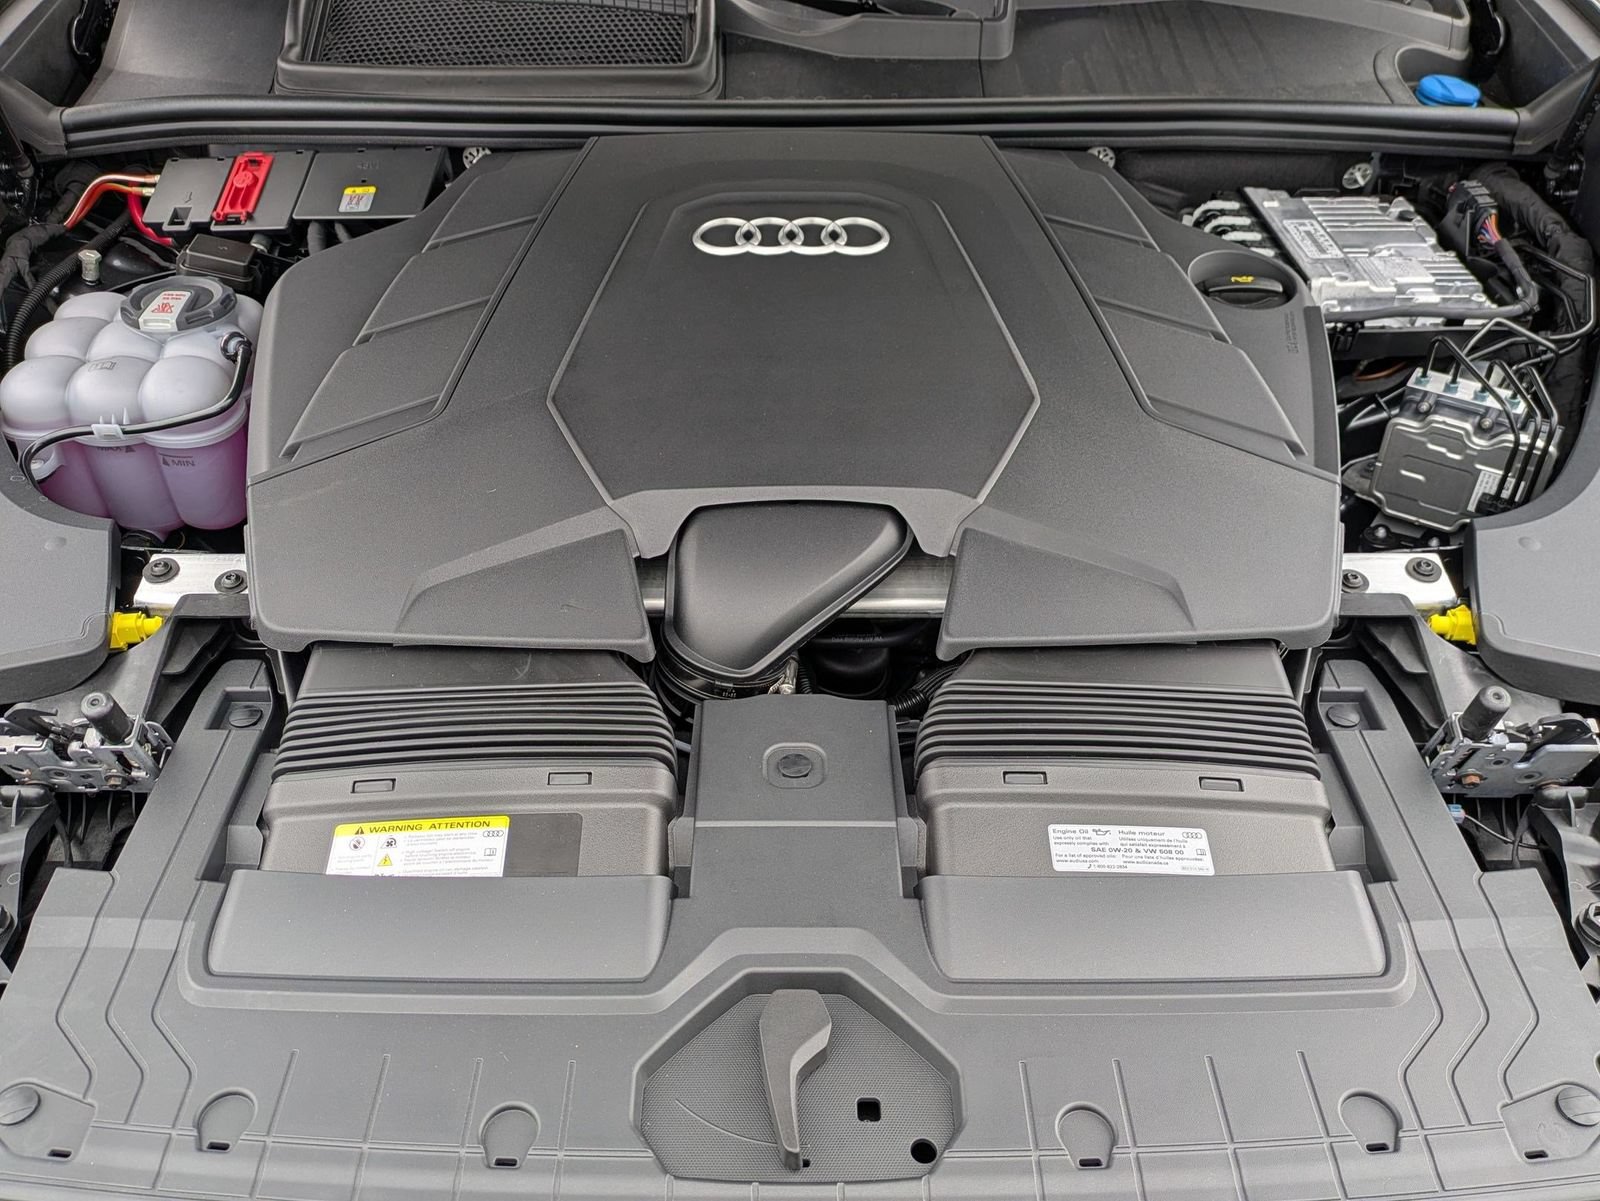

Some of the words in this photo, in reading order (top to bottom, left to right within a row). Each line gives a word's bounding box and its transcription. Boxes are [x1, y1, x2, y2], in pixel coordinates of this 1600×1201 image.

[172, 459, 195, 467] MIN
[369, 823, 423, 833] WARNING
[429, 820, 491, 830] ATTENTION
